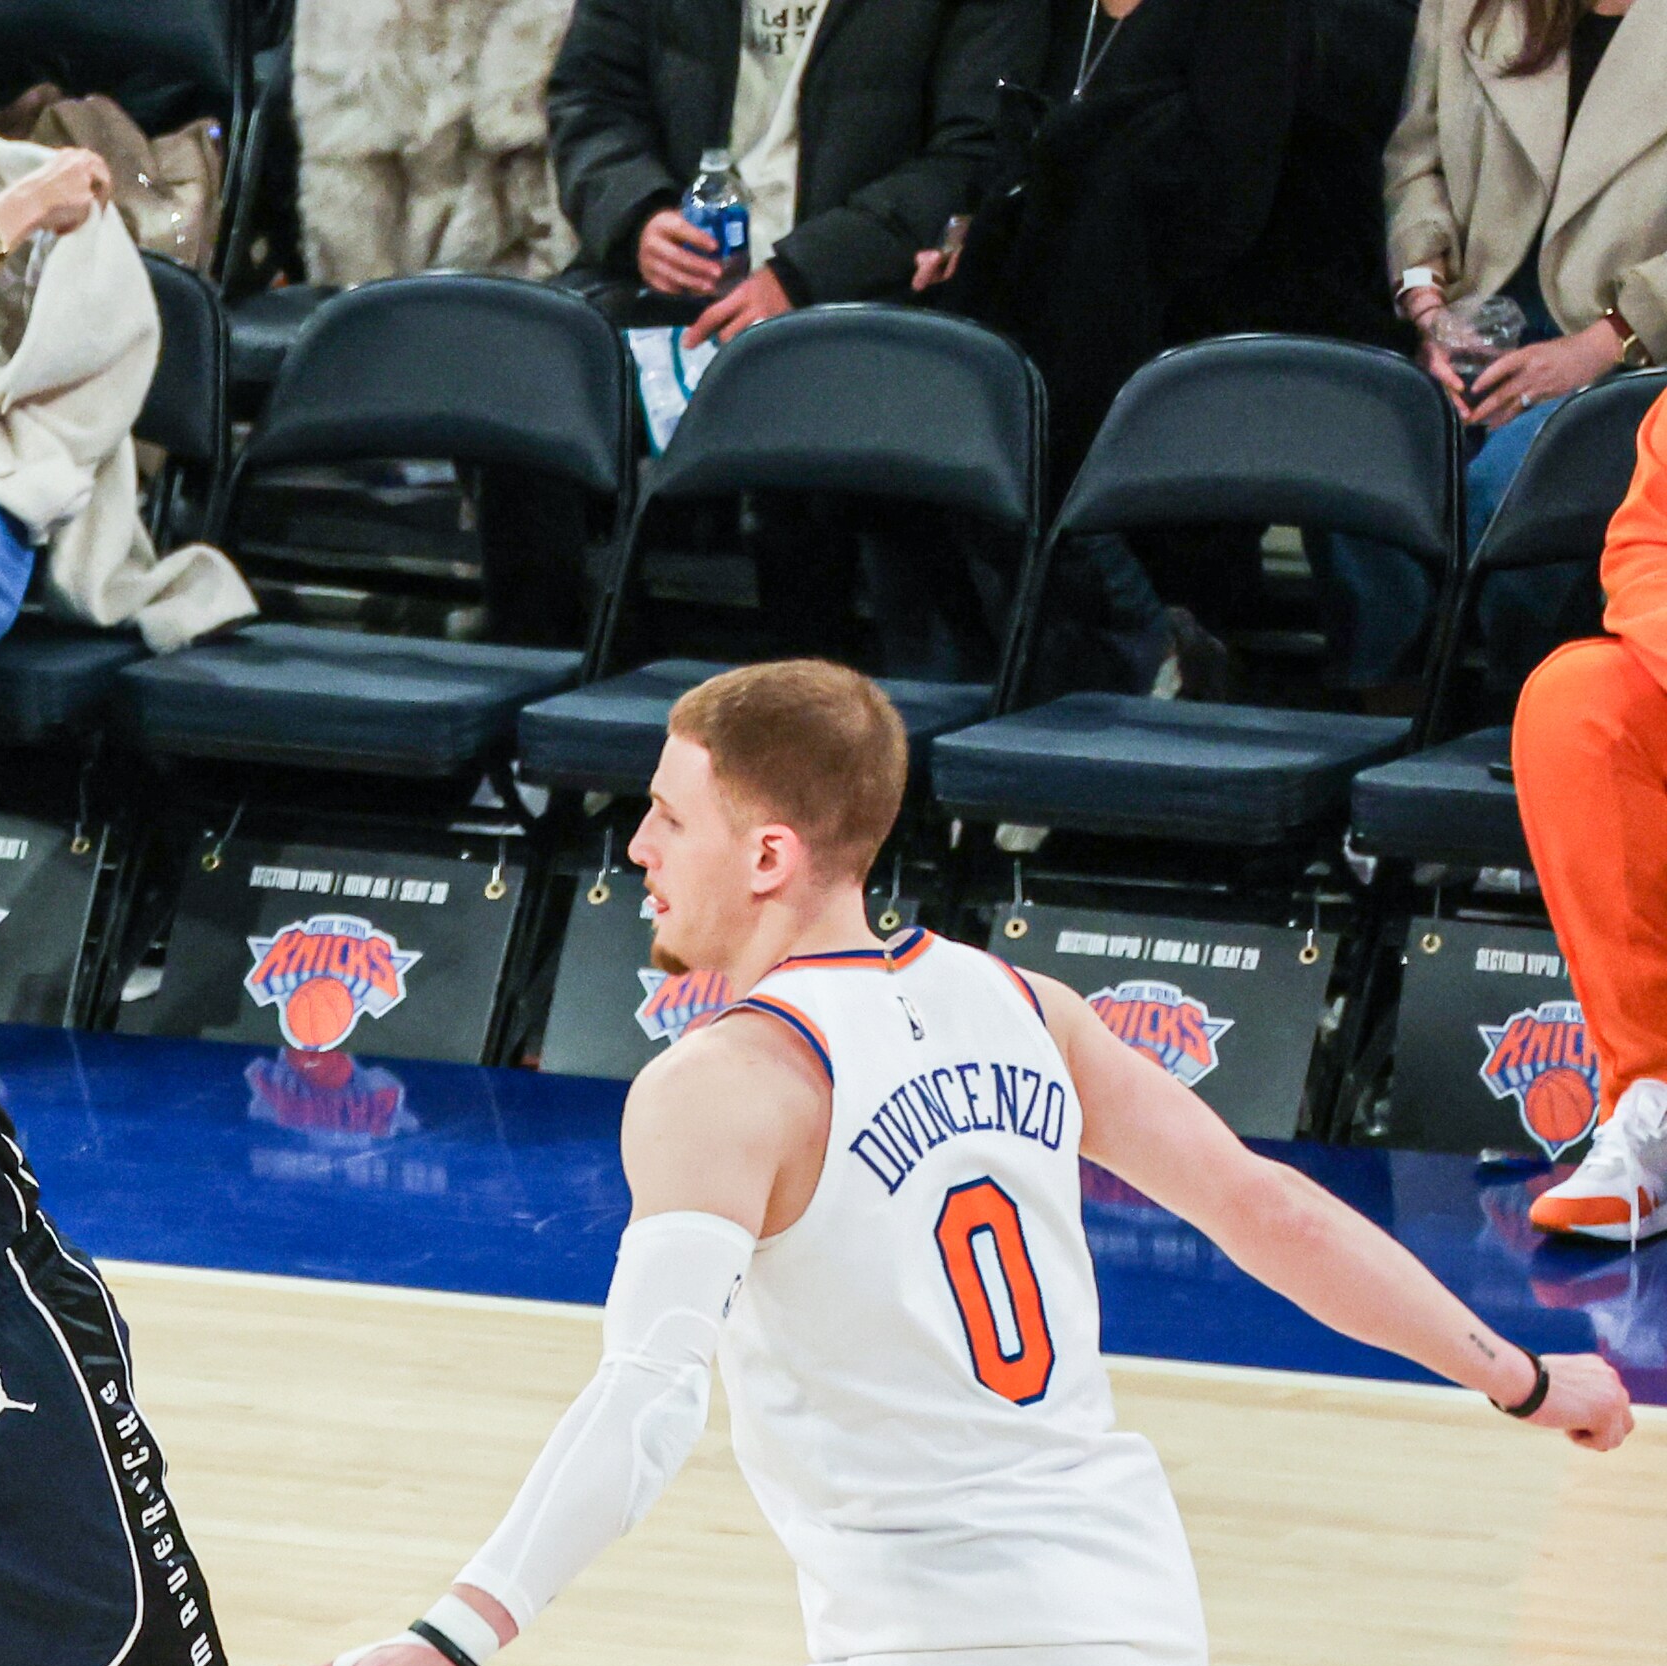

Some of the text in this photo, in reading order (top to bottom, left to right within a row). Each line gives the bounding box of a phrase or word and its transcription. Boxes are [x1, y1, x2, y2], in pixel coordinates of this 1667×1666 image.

[250, 928, 400, 1000] KNICKS
[848, 1062, 1065, 1197] DIVINCENZO
[934, 1174, 1056, 1408] 0
